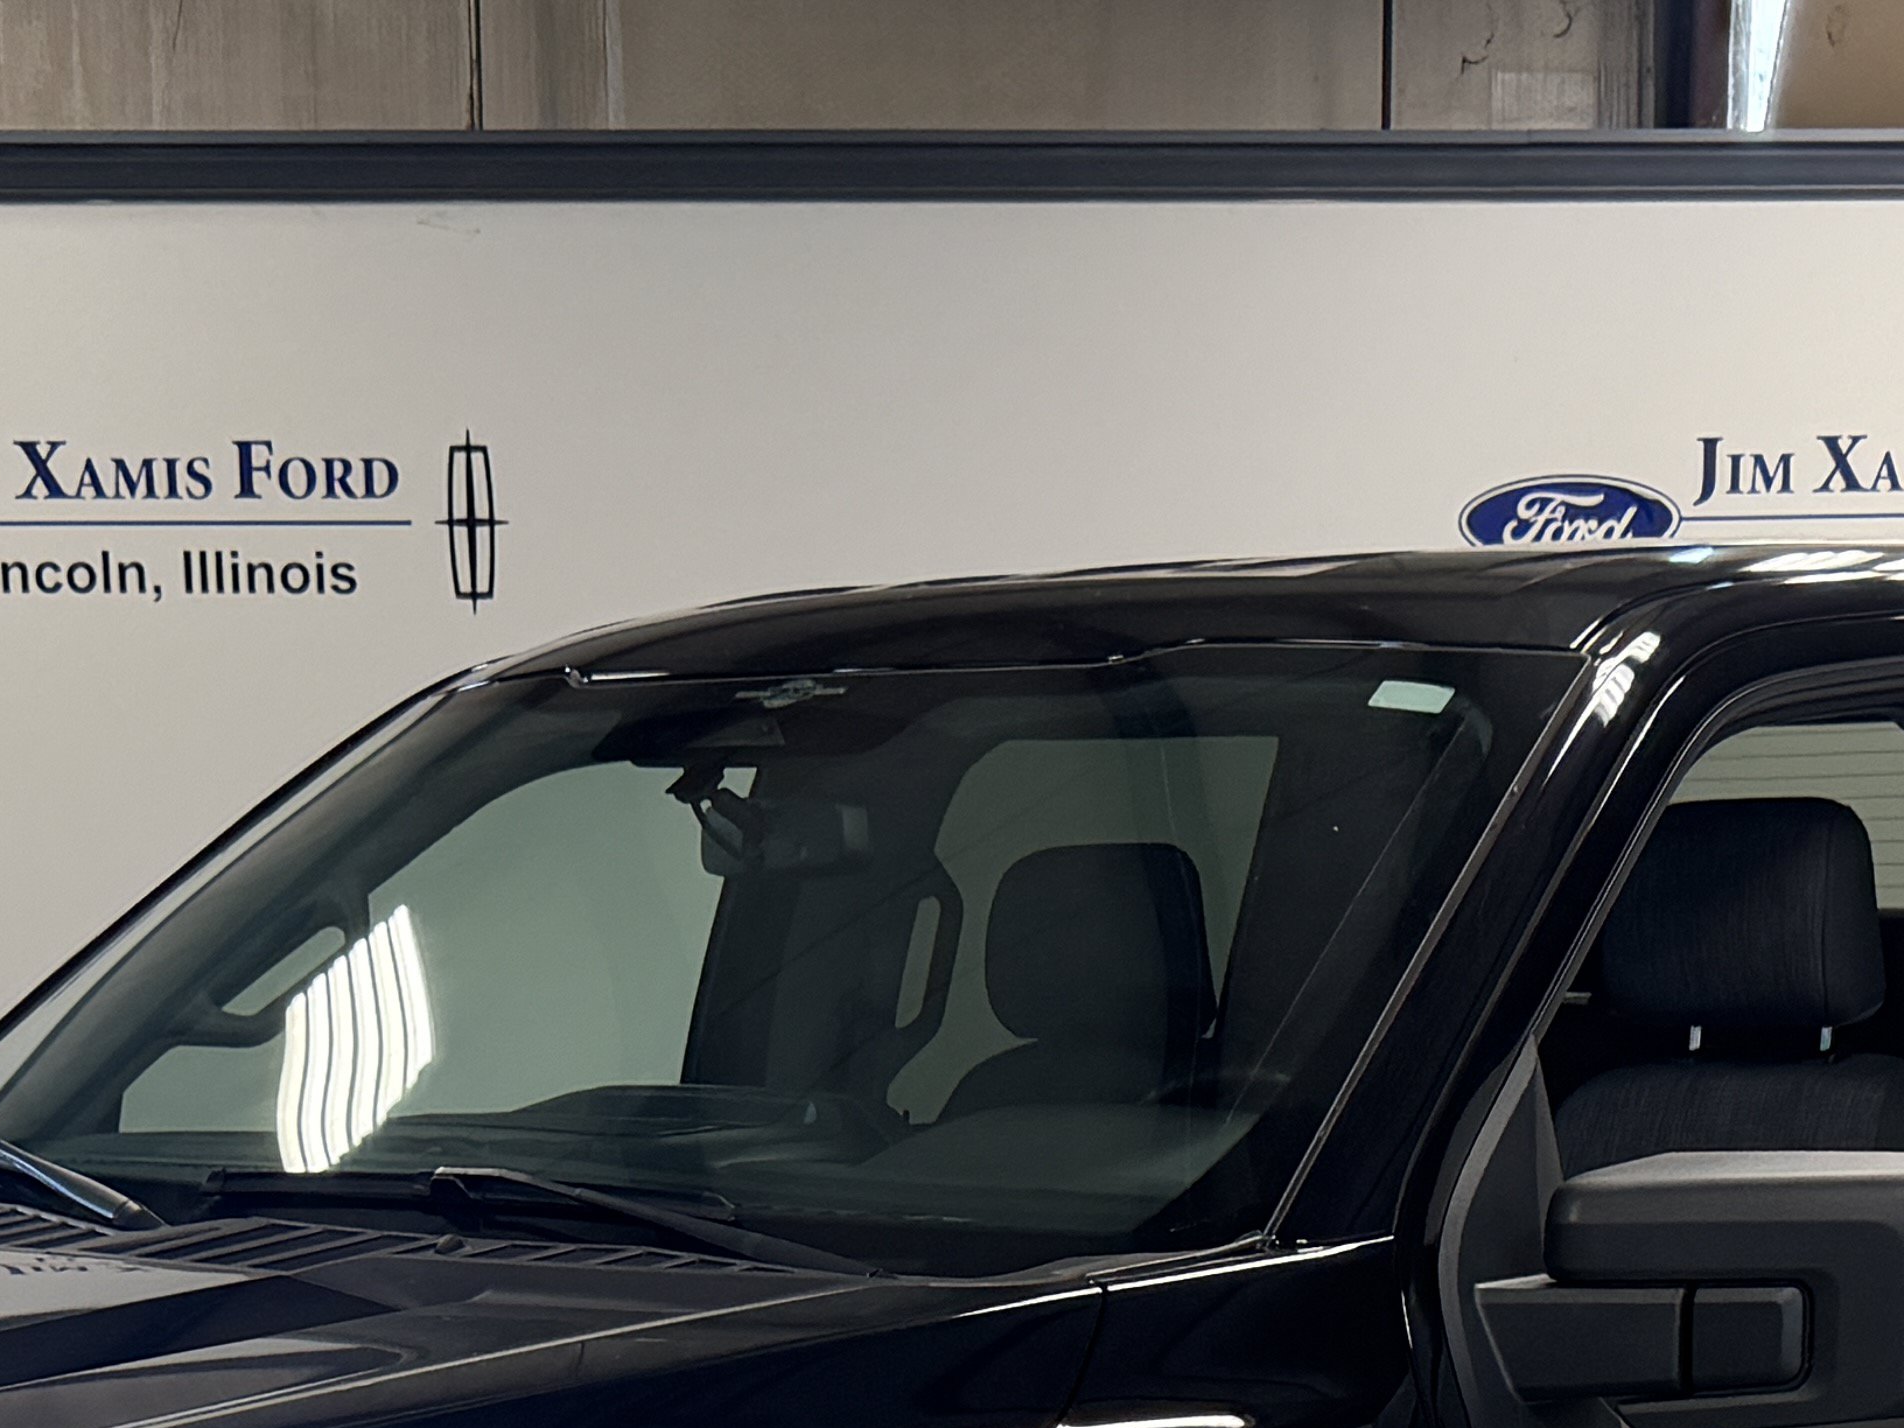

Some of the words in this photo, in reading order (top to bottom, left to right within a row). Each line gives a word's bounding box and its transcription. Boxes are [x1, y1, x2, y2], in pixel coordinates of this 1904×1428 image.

[13, 440, 213, 501] XAMIS
[232, 440, 399, 500] FORD
[1693, 435, 1794, 507] JIM
[1502, 491, 1639, 545] Ford
[182, 549, 359, 596] Illinois
